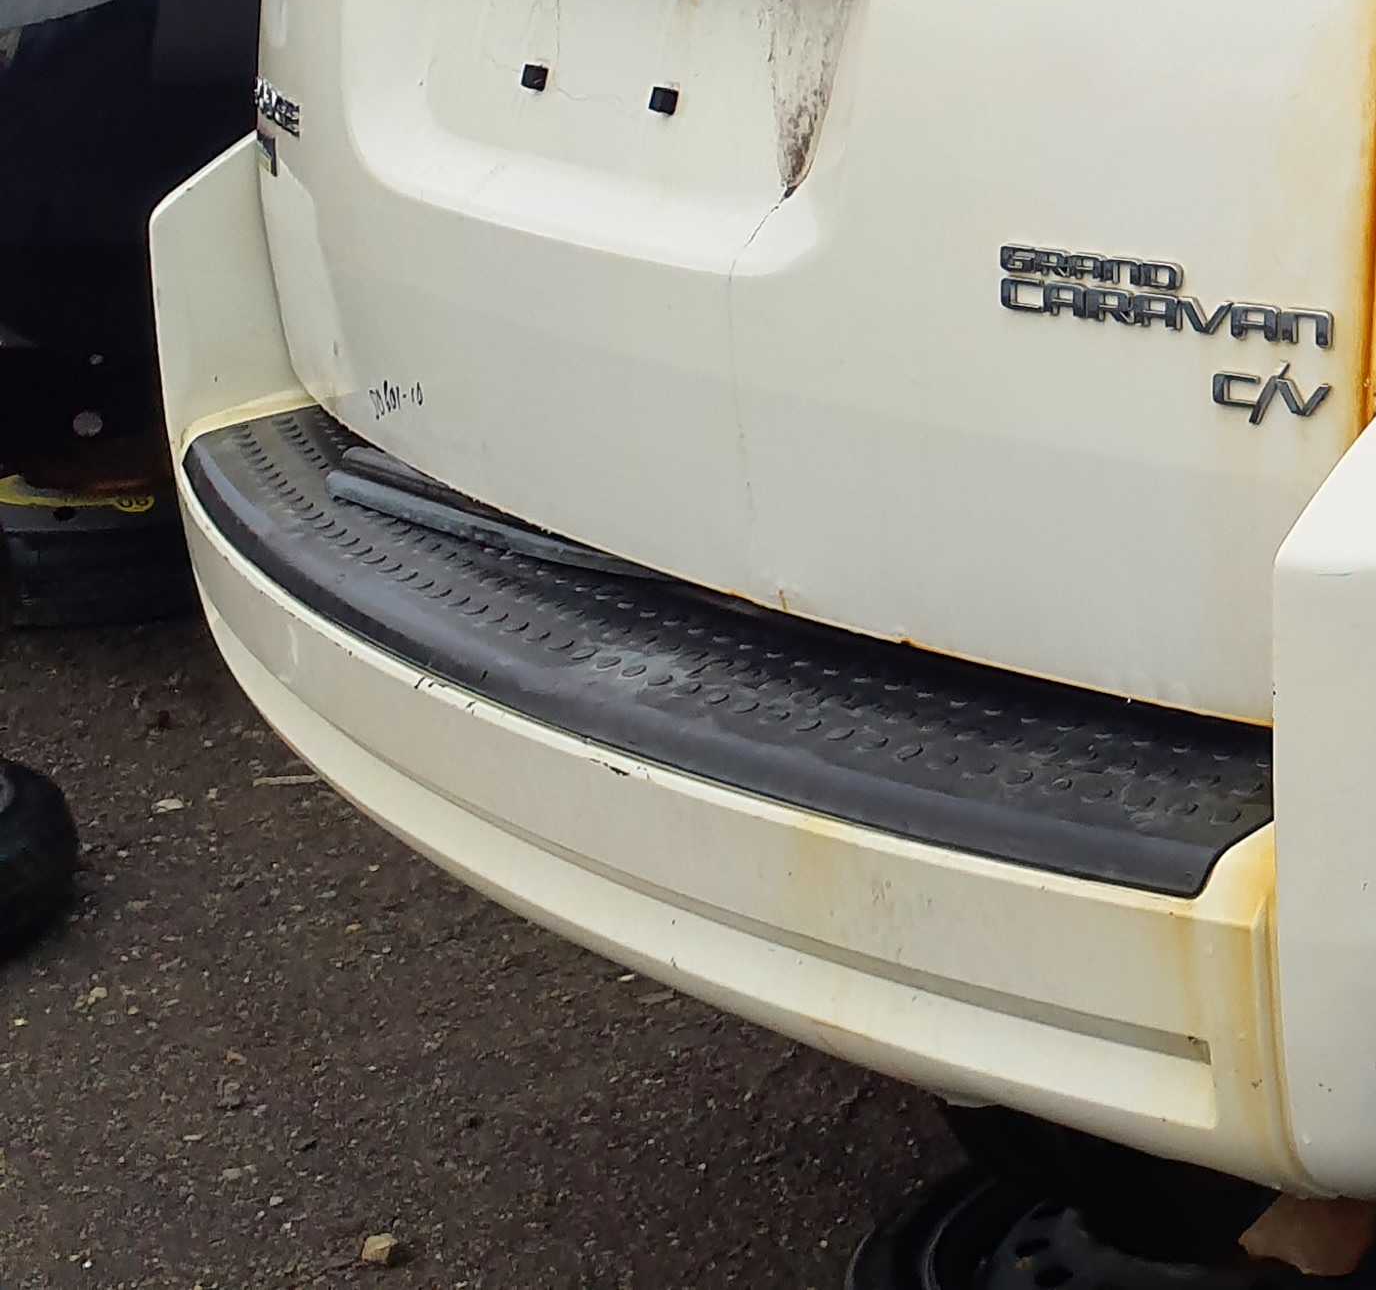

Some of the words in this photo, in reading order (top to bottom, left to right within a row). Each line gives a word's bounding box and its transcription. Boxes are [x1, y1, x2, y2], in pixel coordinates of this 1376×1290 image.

[1000, 242, 1184, 292] GRAND
[1000, 276, 1335, 350] CARAVAN
[1212, 360, 1332, 425] C/V
